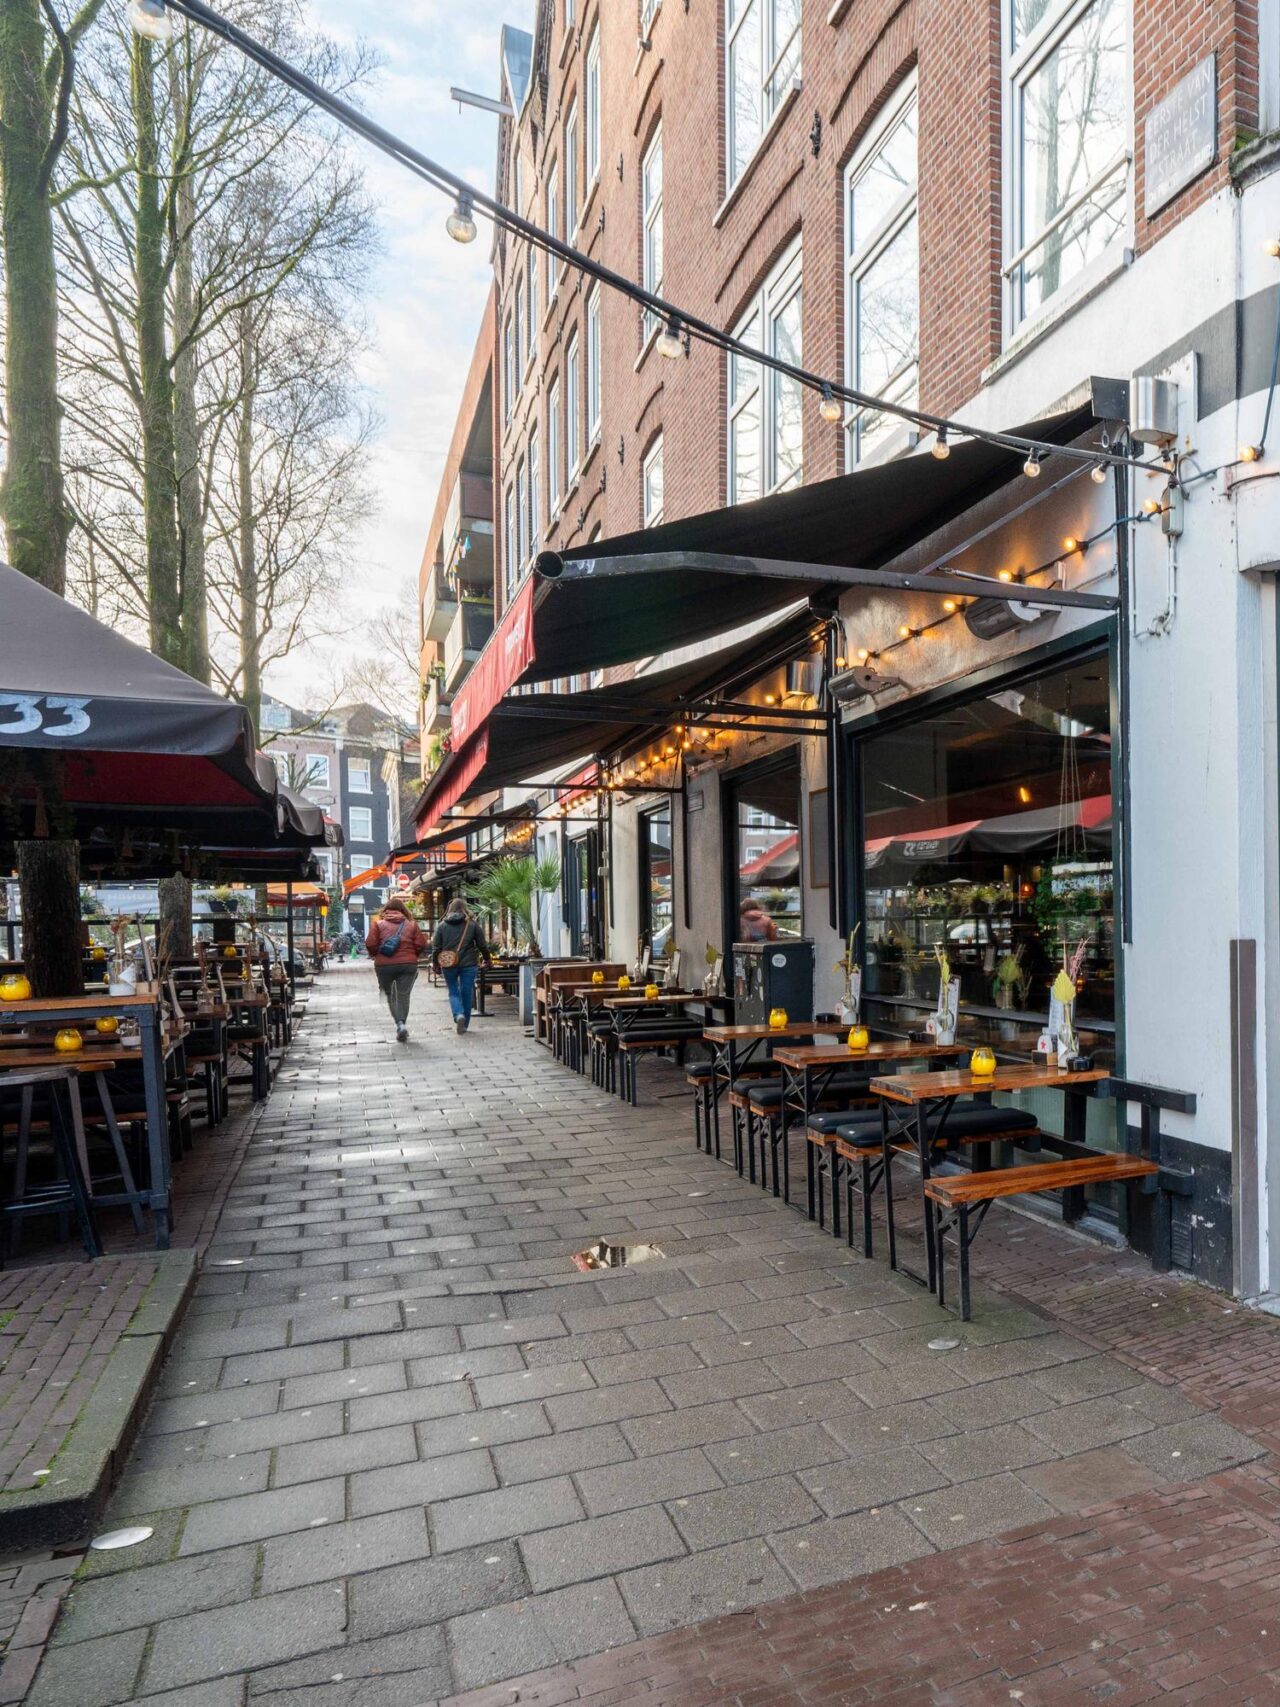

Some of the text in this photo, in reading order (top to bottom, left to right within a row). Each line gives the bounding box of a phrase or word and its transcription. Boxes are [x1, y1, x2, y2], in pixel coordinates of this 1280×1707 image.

[1187, 62, 1211, 96] VAN
[1150, 131, 1170, 164] DER
[1174, 93, 1208, 137] HELST
[1158, 128, 1198, 177] STRAAT
[0, 693, 93, 736] 33
